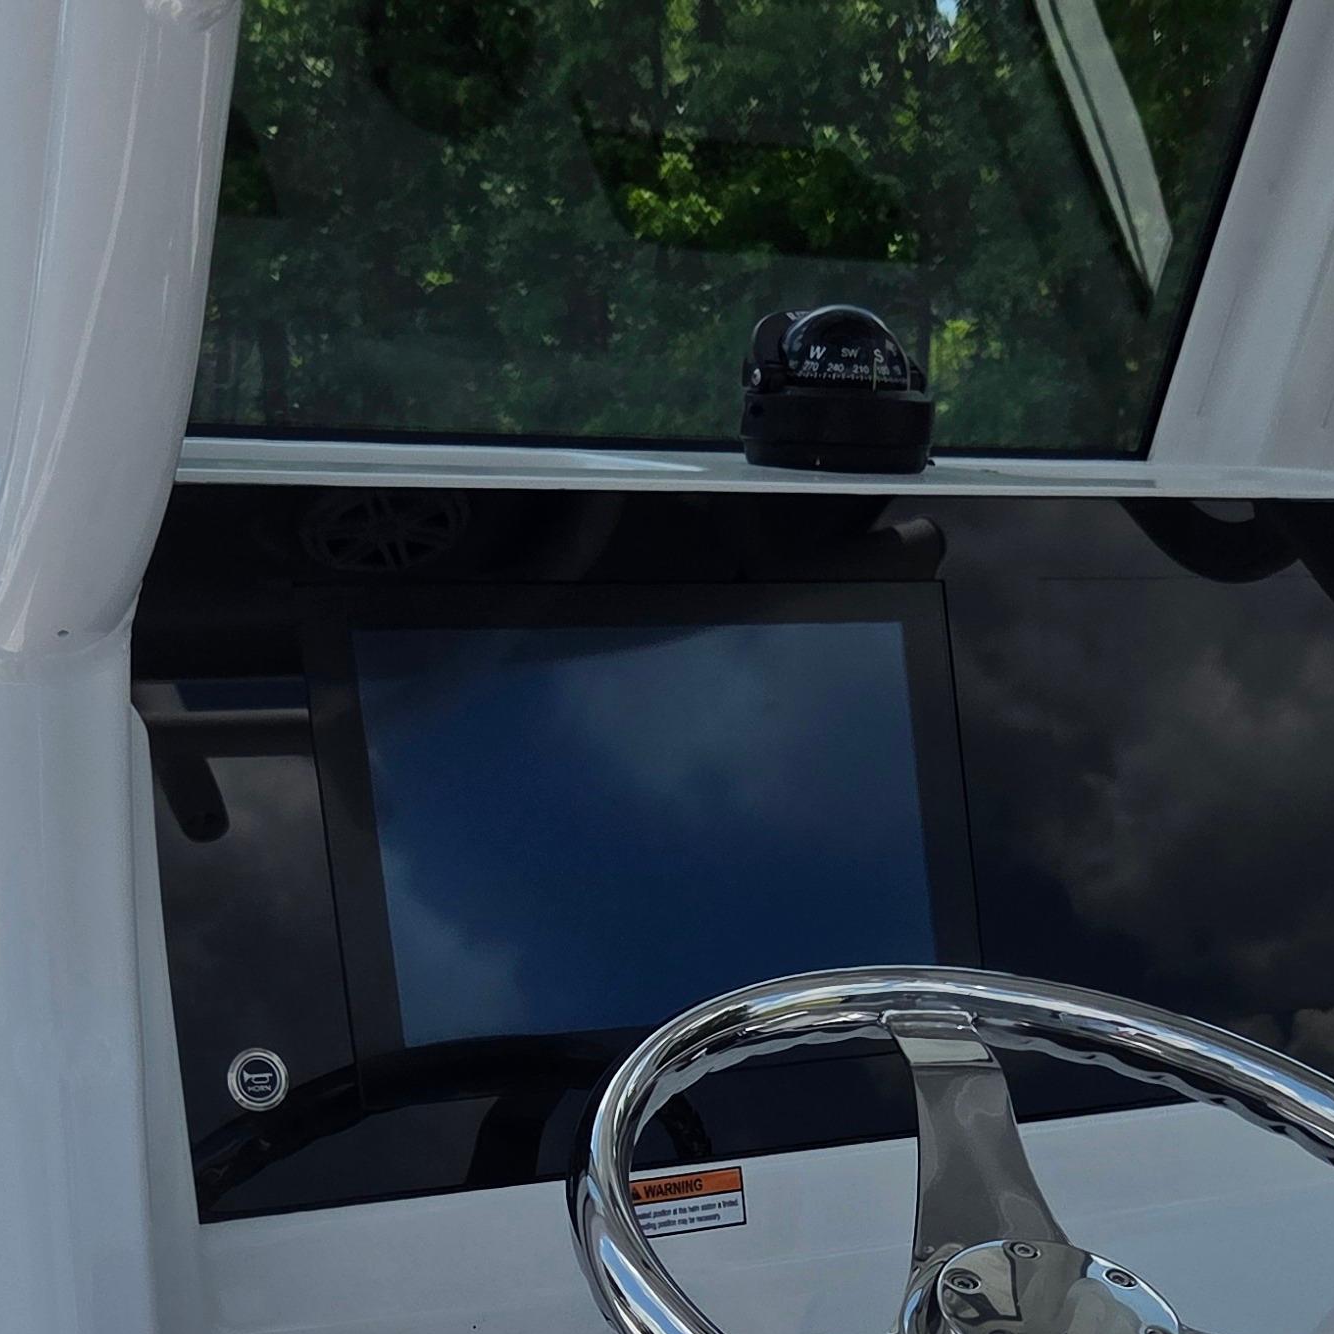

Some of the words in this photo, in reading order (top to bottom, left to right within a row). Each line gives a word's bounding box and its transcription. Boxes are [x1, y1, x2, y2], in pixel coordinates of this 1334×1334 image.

[809, 345, 826, 360] W
[841, 347, 860, 359] SW
[873, 348, 885, 363] S
[643, 1178, 703, 1199] WARNING
